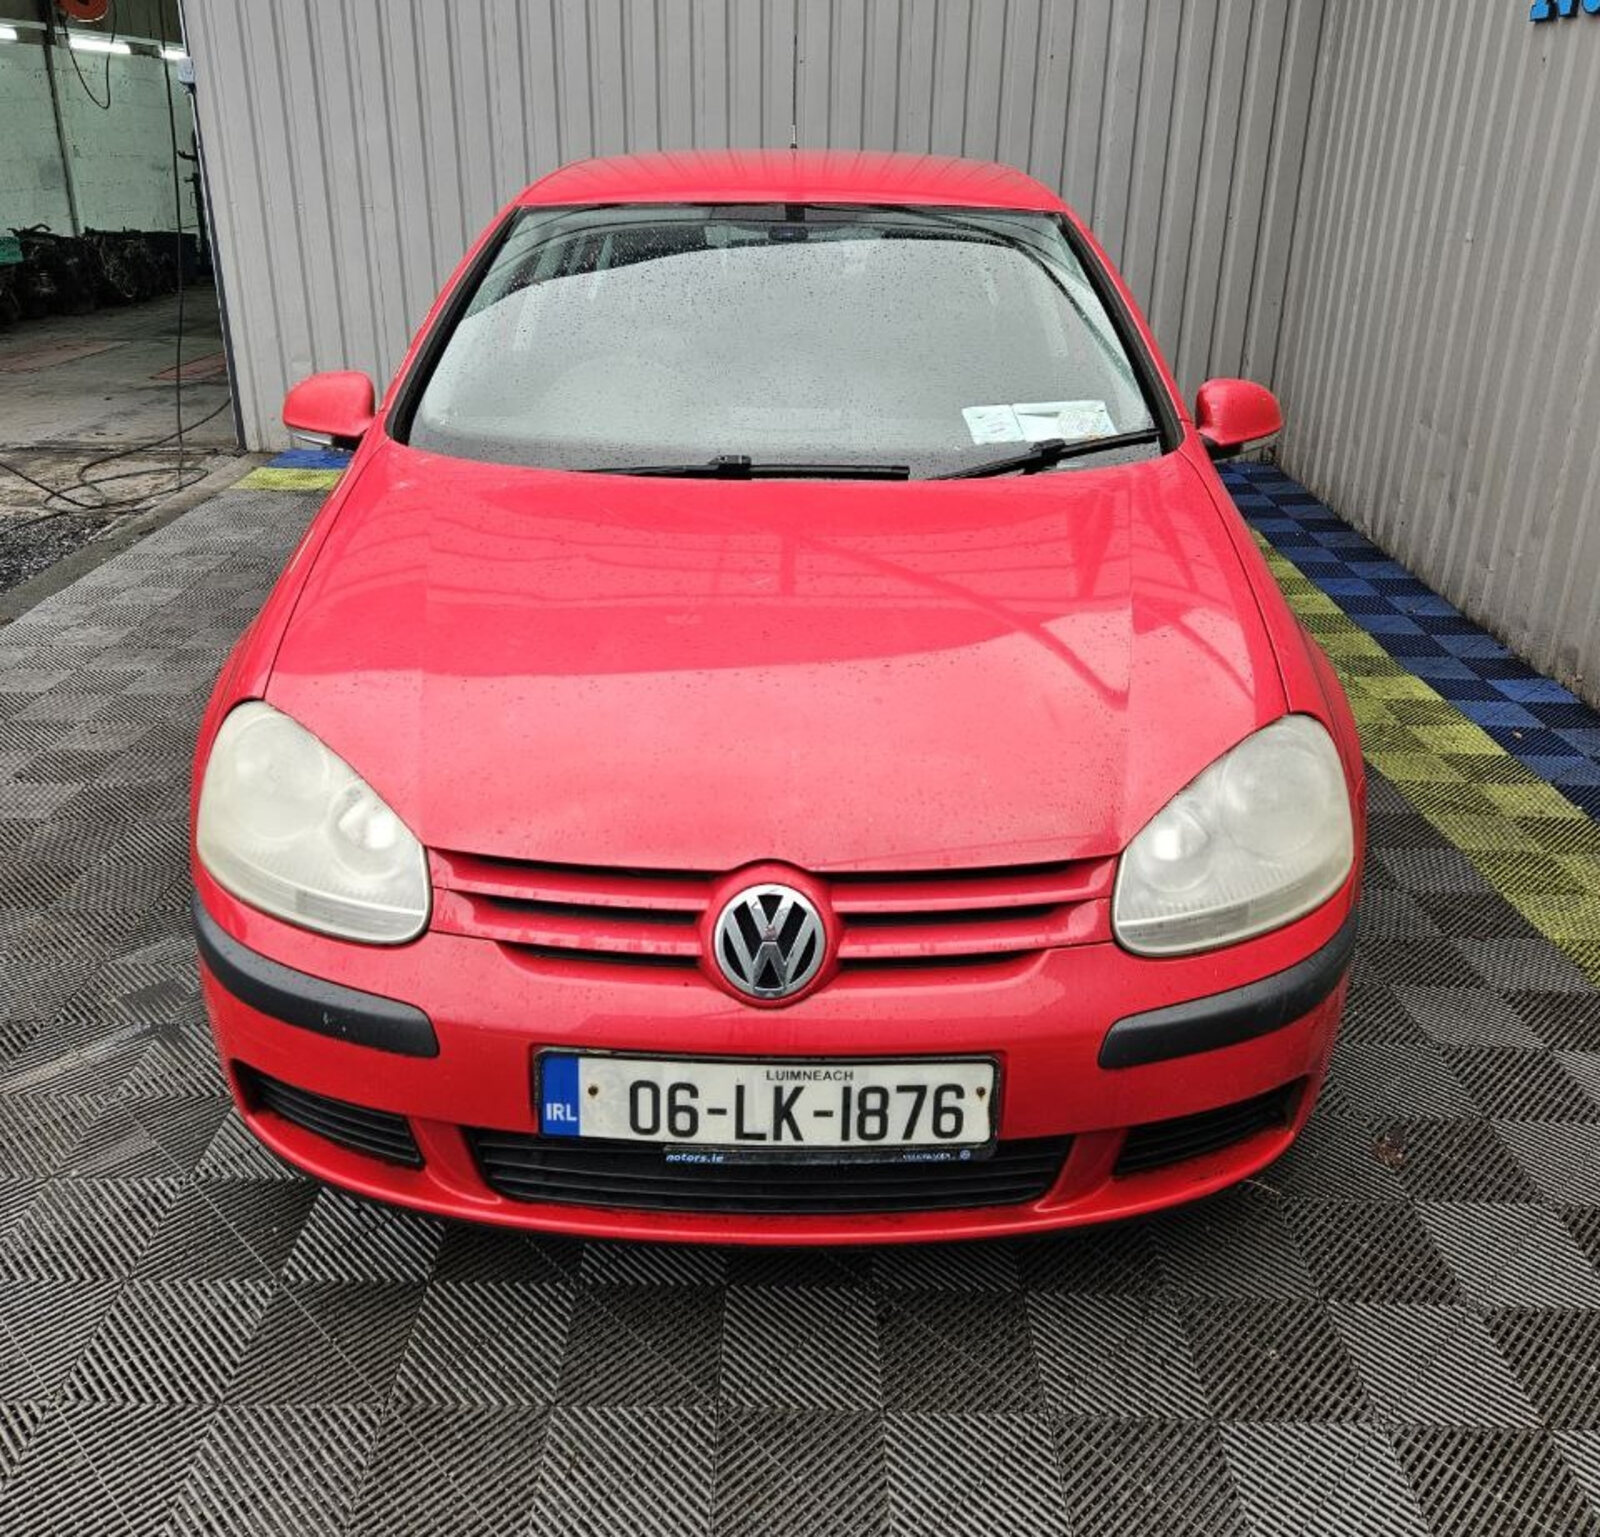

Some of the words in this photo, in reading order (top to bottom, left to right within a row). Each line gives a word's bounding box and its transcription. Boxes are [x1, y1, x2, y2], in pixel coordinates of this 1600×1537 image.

[765, 1069, 854, 1081] LUIMNEACH
[546, 1102, 578, 1122] IRL
[629, 1080, 965, 1142] 06-LK-1876
